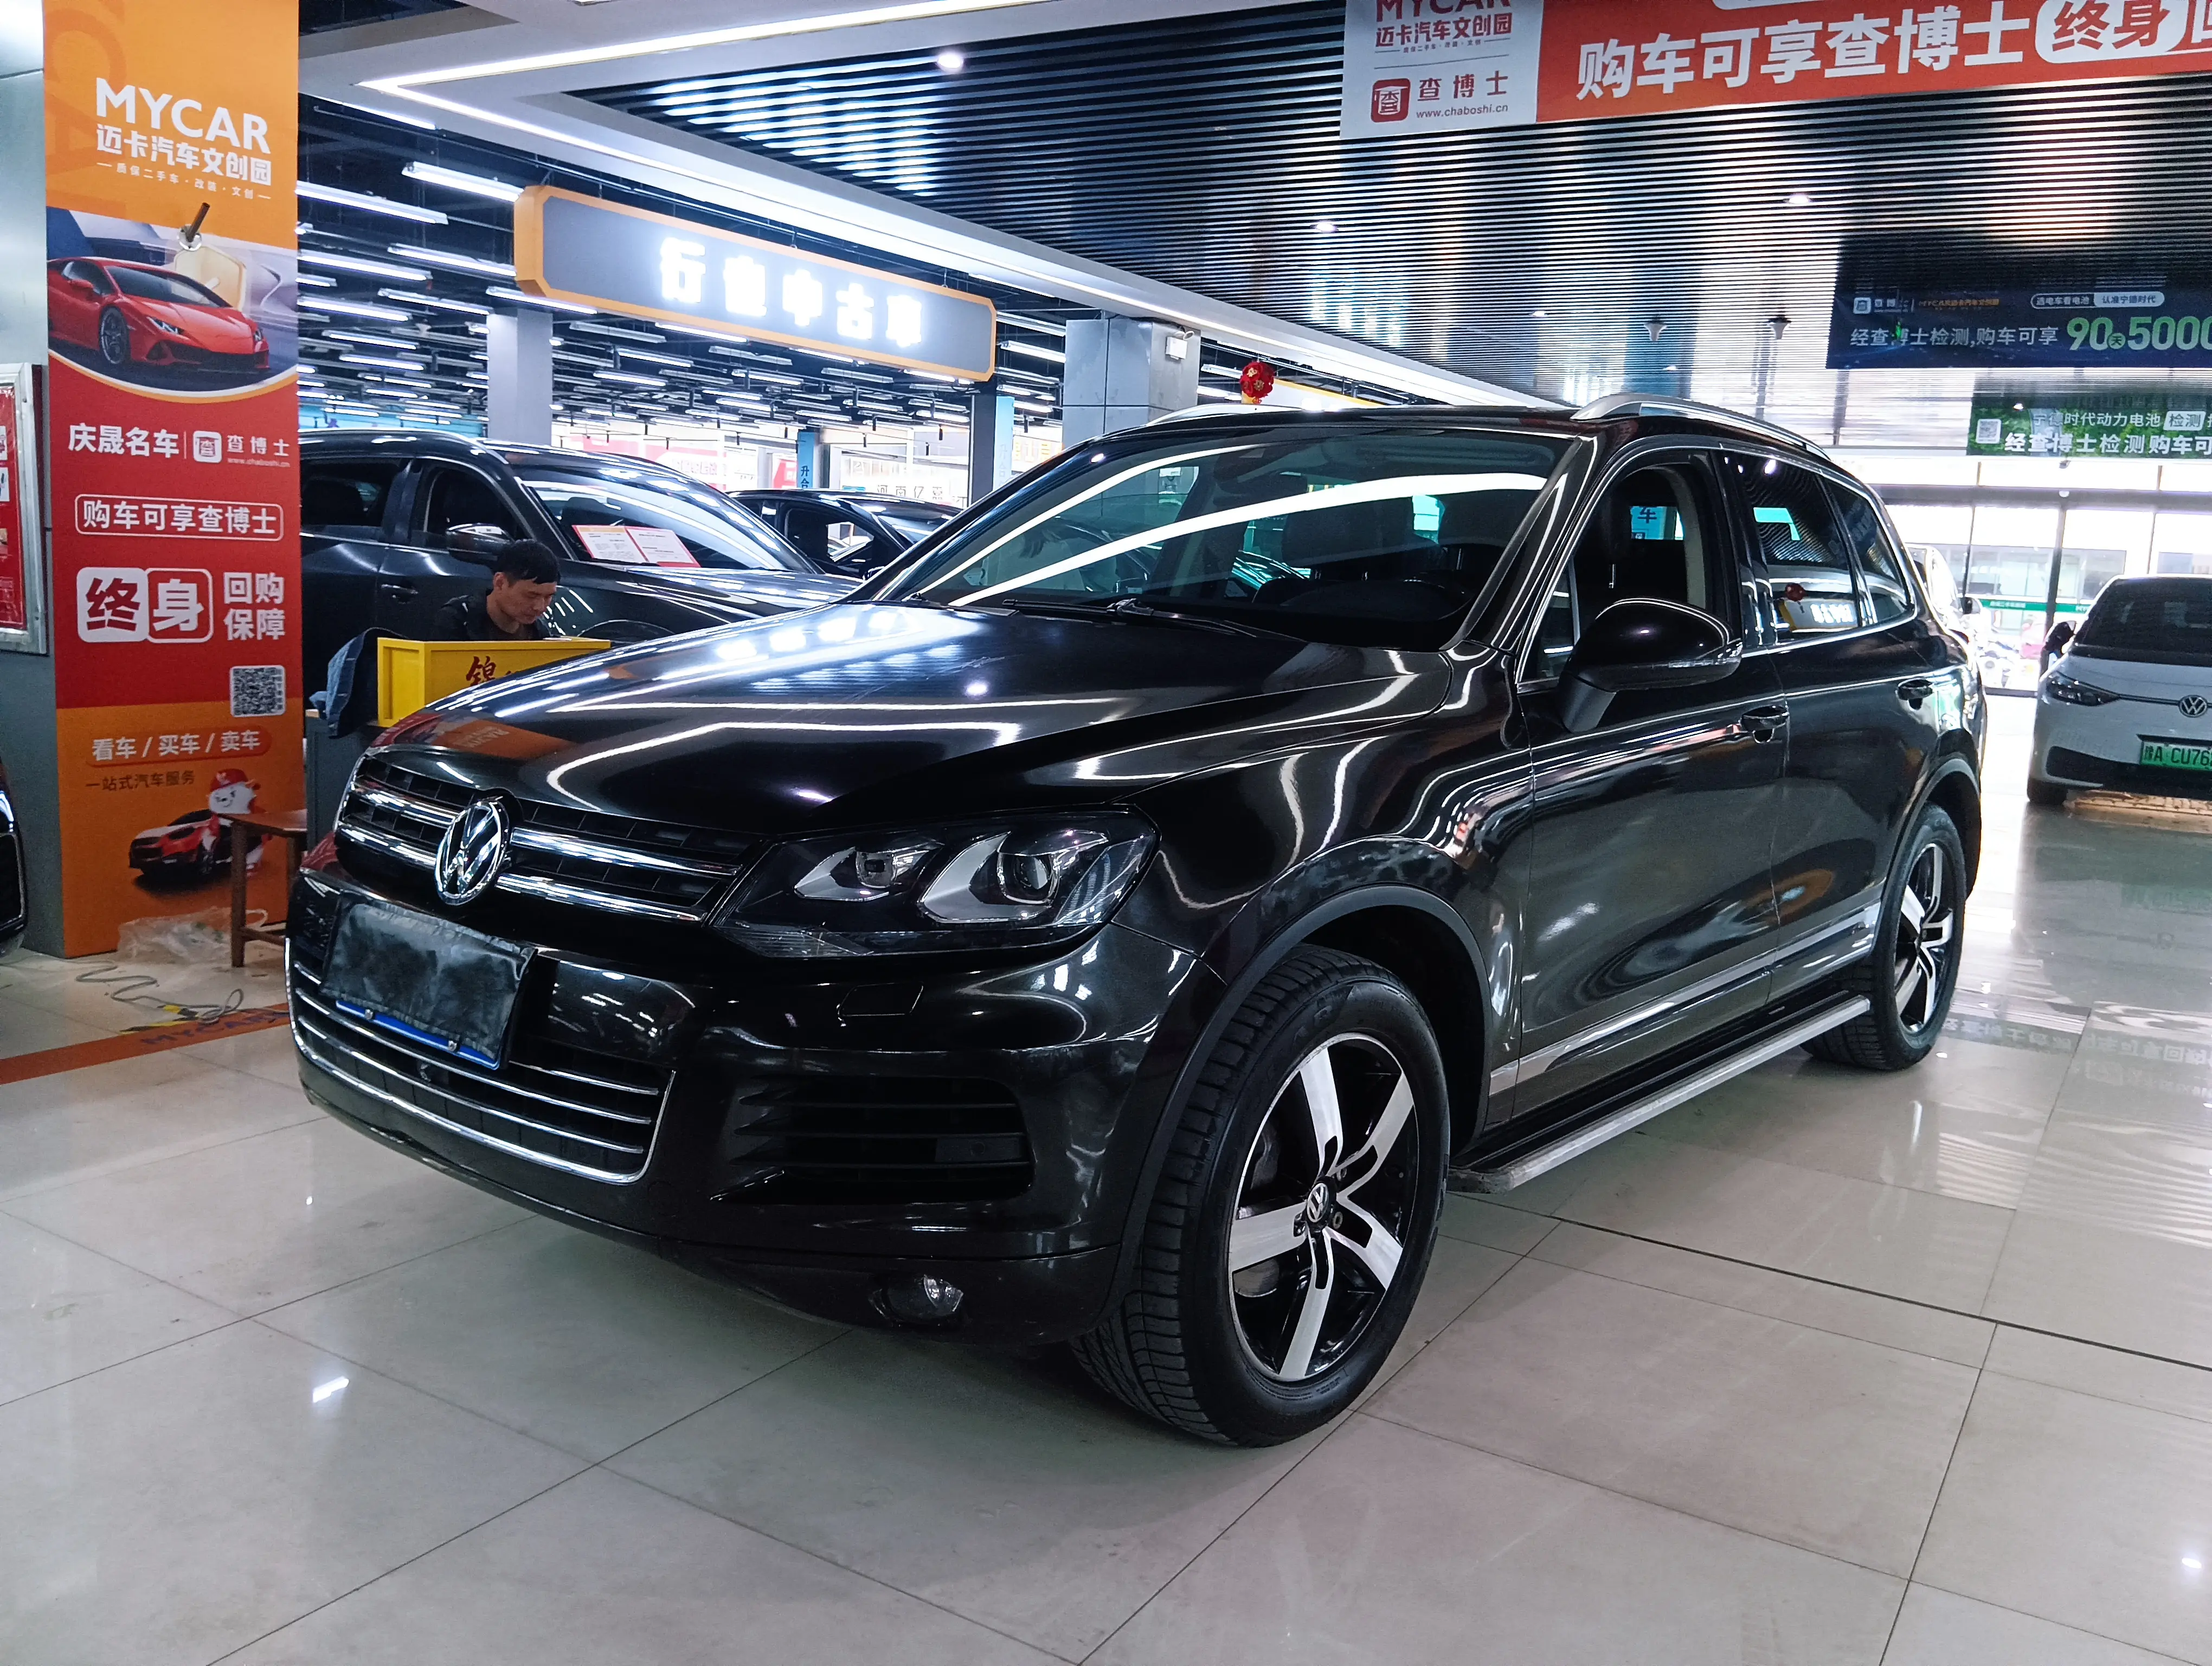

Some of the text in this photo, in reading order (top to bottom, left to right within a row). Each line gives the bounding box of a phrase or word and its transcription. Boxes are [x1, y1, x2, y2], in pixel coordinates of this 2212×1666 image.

[1376, 0, 1511, 22] MYC
[1375, 12, 1512, 47] 迈卡汽车文创园
[1576, 1, 2029, 101] 购车可享查博士
[1417, 71, 1508, 101] 查博士
[96, 77, 271, 155] MYCAR
[1416, 104, 1508, 118] www.chaboshi.cn
[97, 124, 271, 185] 迈卡汽车文创园
[2032, 412, 2160, 428] 宁德时代动力电池
[2169, 414, 2201, 428] 检测
[68, 423, 179, 459] 庆晟名车
[227, 434, 290, 457] 查博士
[83, 499, 277, 535] 购车可享查博士
[85, 578, 204, 632] 终身
[223, 572, 285, 605] 回购
[224, 608, 285, 641] 保障
[86, 770, 195, 792] 一站式汽车服务
